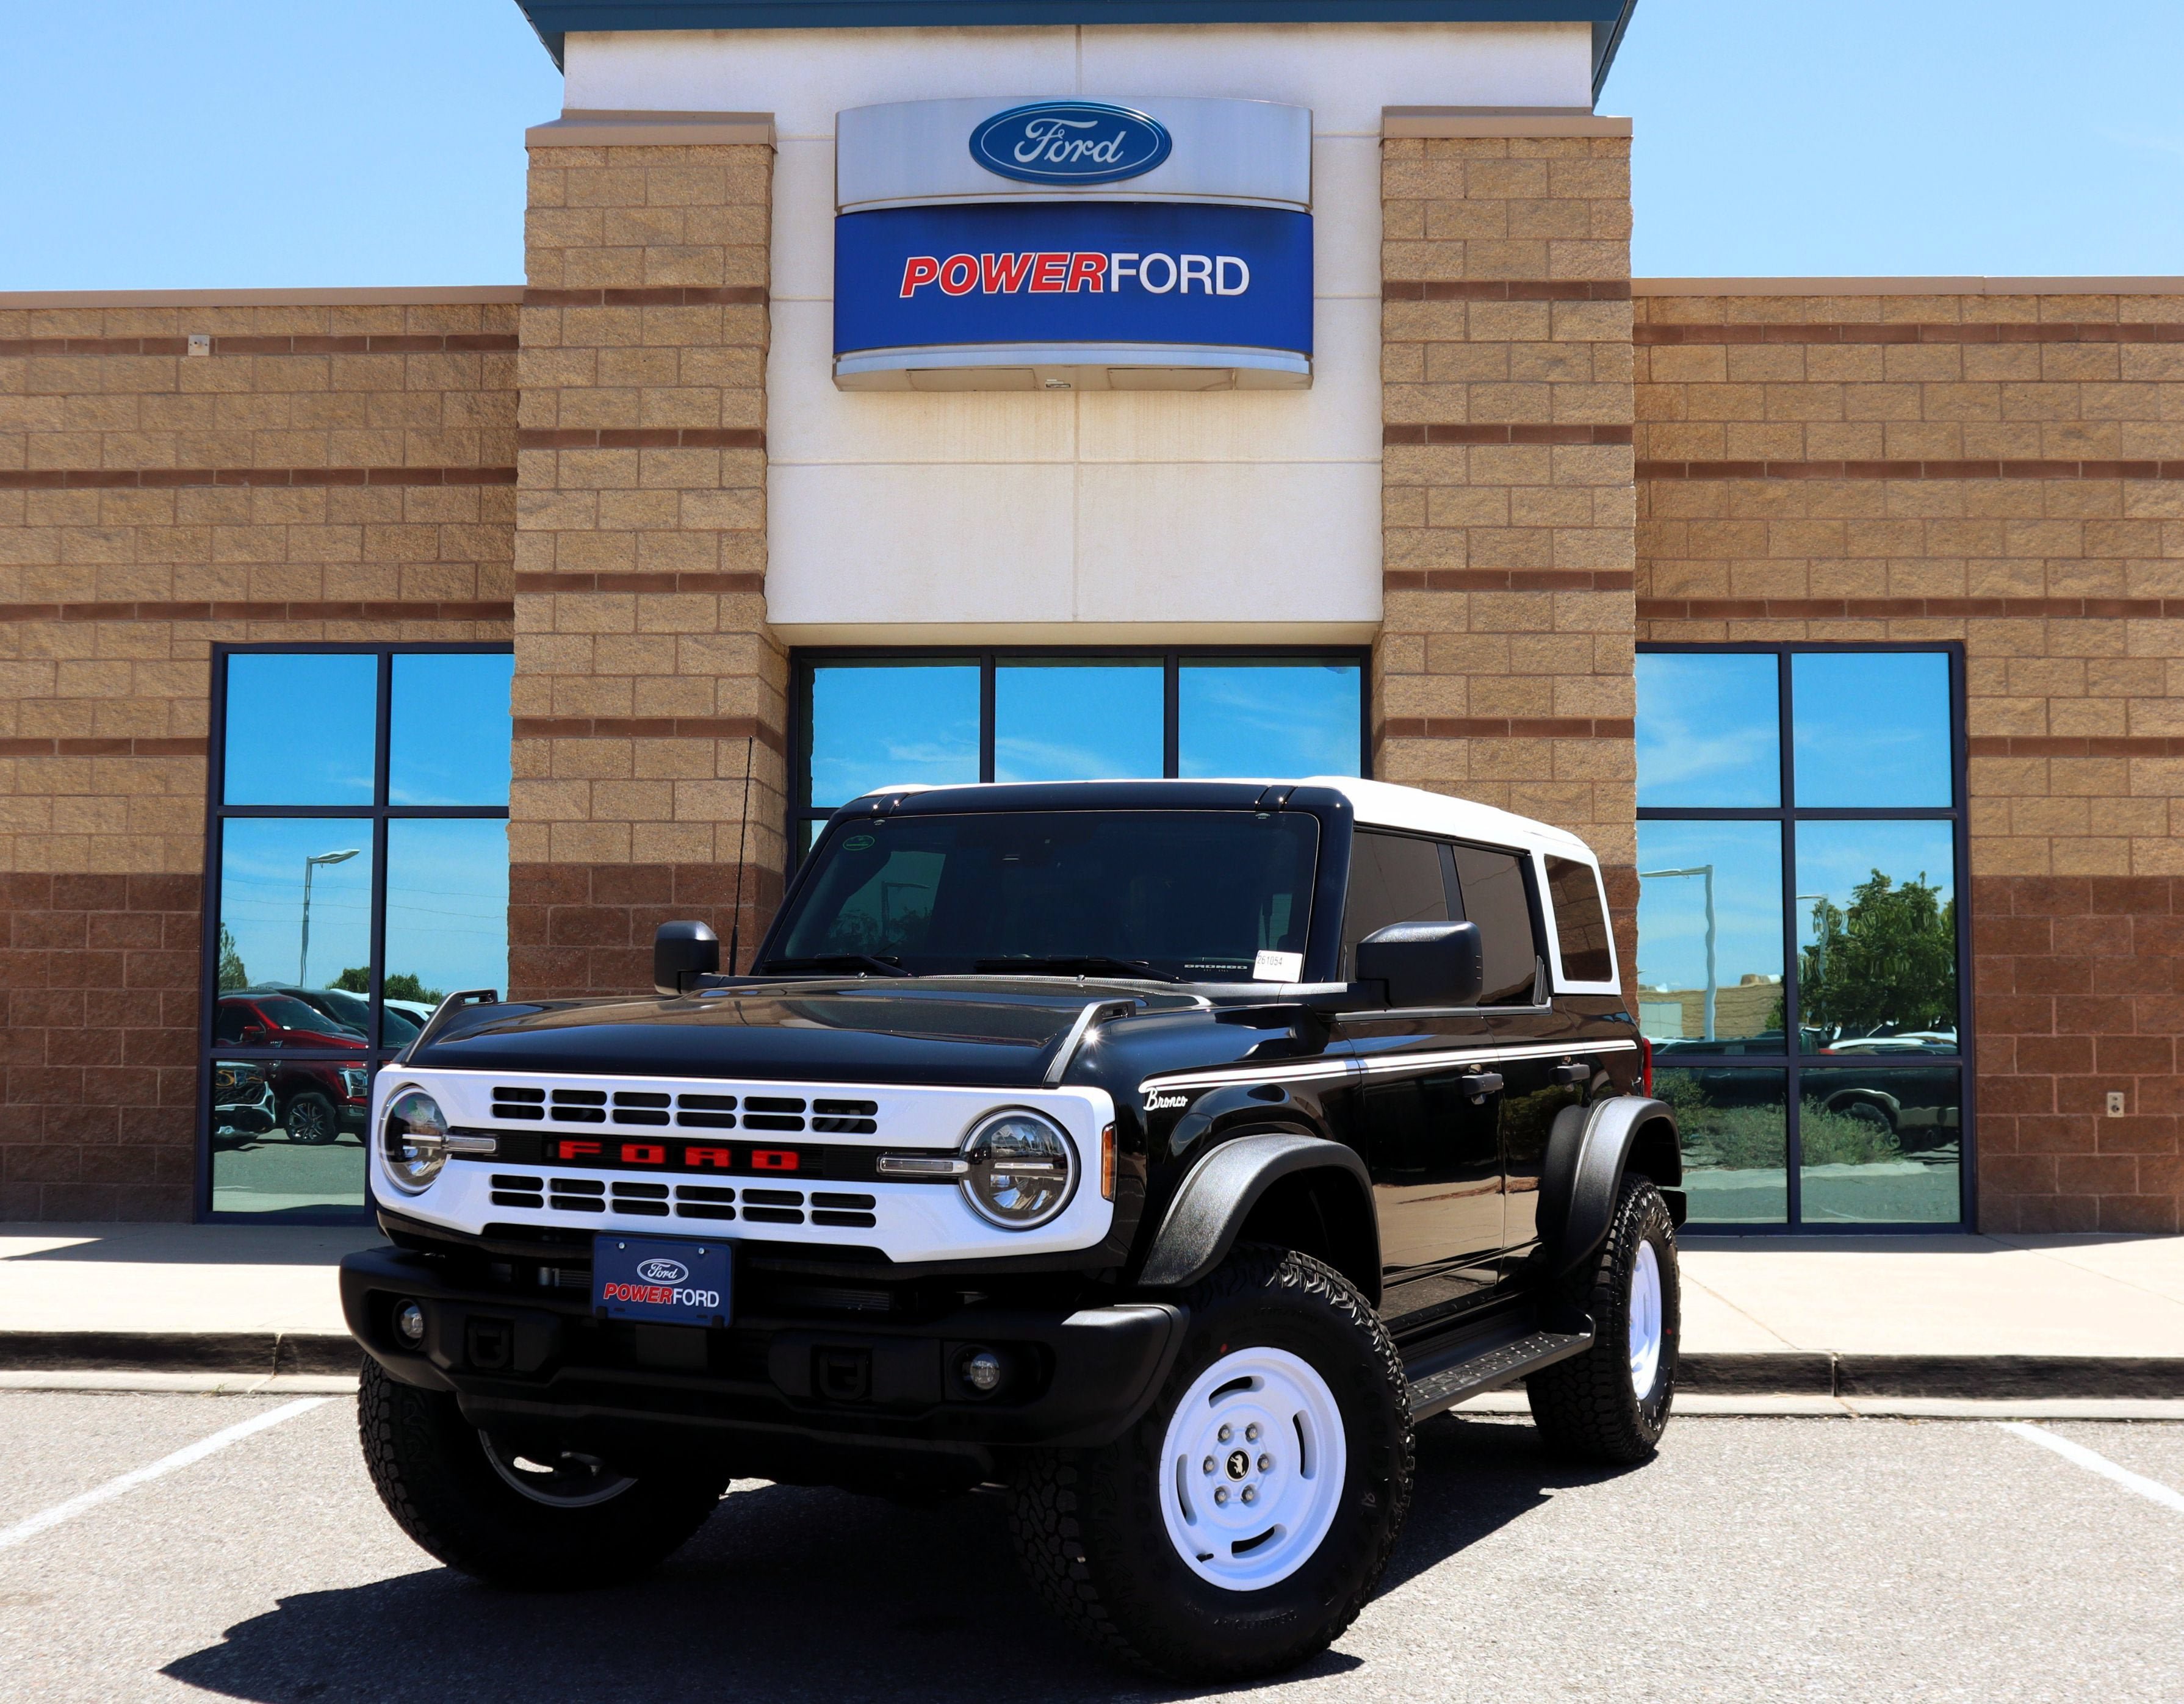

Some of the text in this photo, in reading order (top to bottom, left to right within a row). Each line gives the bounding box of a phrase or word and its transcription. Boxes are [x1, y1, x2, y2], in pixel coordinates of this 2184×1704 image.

[1014, 118, 1126, 163] Ford
[1257, 955, 1283, 966] 261054
[1143, 1087, 1188, 1111] Bronco
[559, 1141, 798, 1170] FORD
[647, 1262, 678, 1279] Ford
